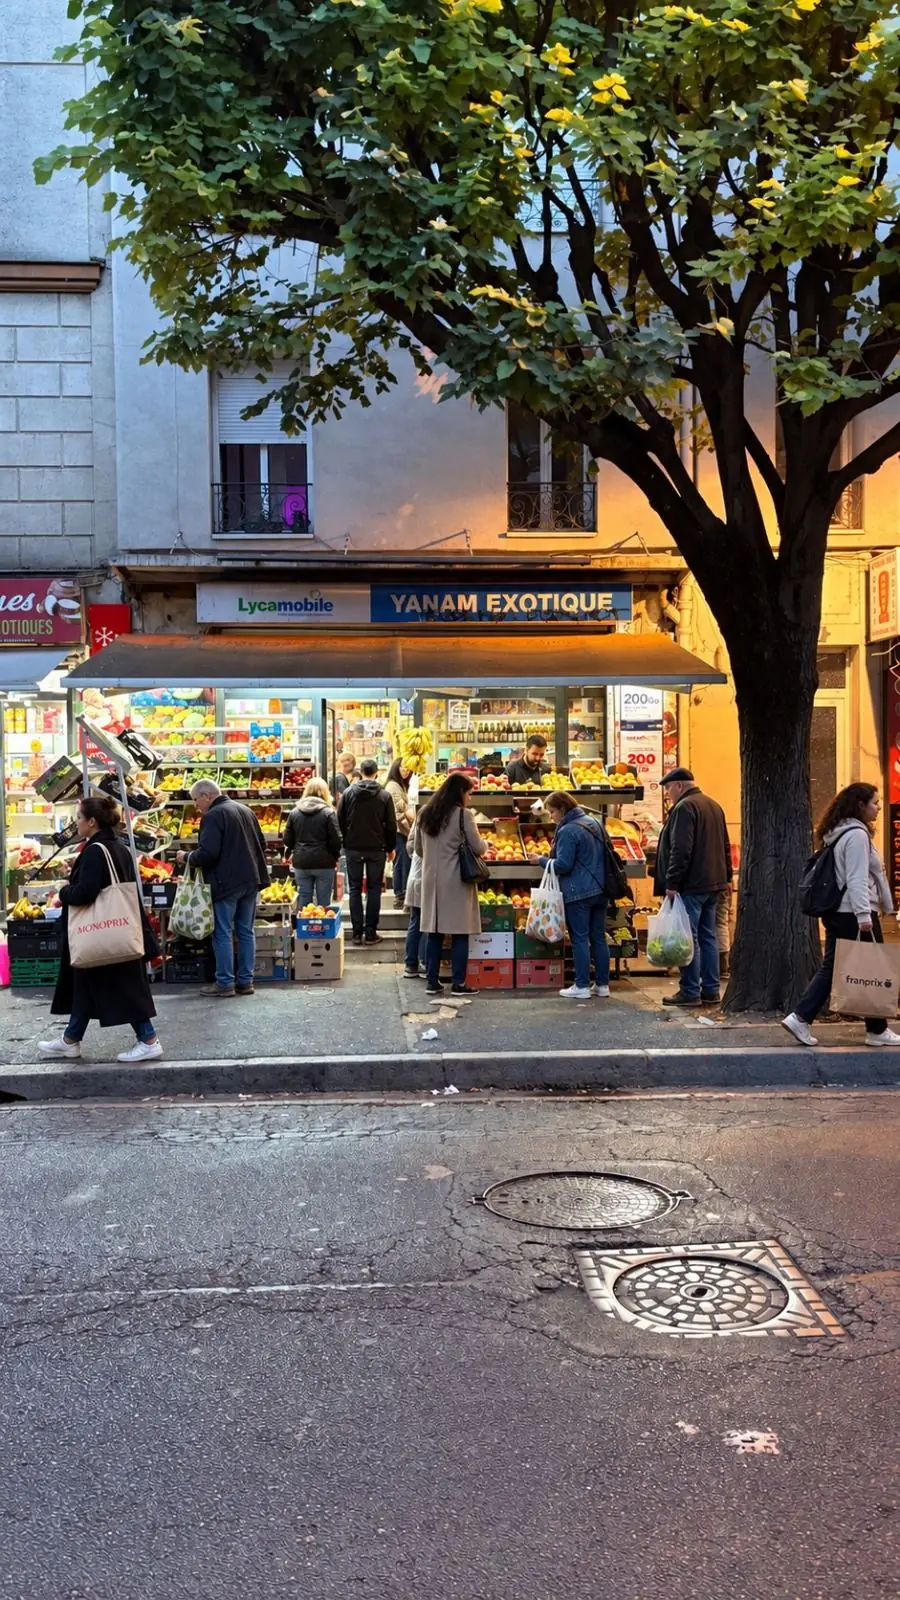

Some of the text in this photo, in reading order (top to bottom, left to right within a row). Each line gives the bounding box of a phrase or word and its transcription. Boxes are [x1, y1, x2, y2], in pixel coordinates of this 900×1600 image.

[238, 597, 334, 615] Lycamobile
[390, 592, 613, 613] YANAM EXOTIQUE
[627, 753, 656, 765] 200
[76, 917, 129, 934] MONOPRIX
[846, 975, 883, 988] franprix
